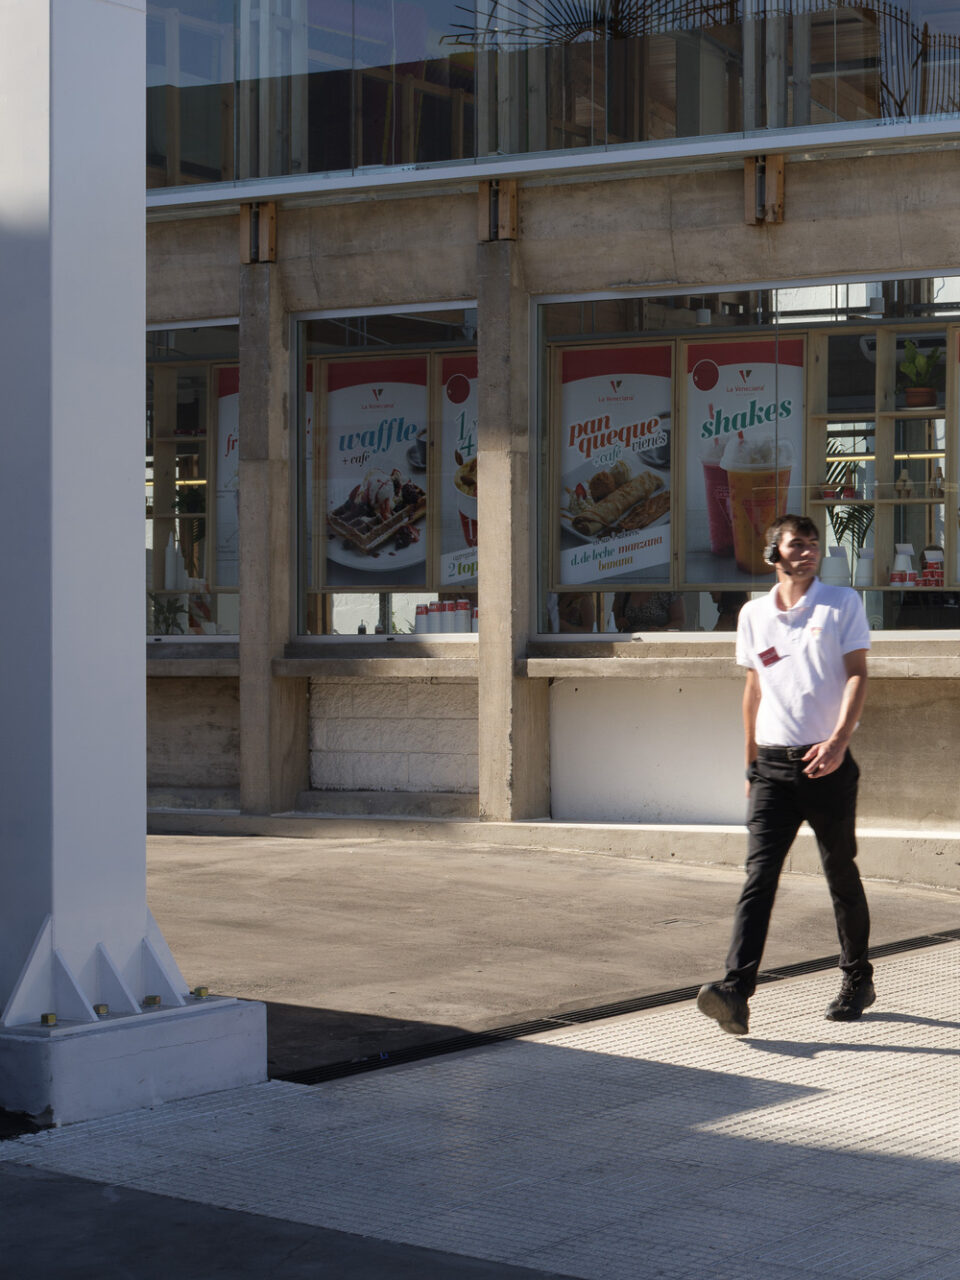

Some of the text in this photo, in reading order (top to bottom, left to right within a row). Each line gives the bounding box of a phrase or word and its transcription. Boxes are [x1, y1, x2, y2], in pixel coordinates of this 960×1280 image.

[701, 400, 792, 439] shakes
[338, 416, 418, 455] waffle
[568, 415, 611, 448] pan
[578, 418, 660, 459] queque
[632, 431, 667, 453] vienés
[350, 451, 370, 468] café
[599, 444, 622, 466] café
[592, 545, 615, 561] leche
[618, 536, 664, 554] manzana
[448, 562, 456, 577] 2
[598, 556, 633, 572] banana
